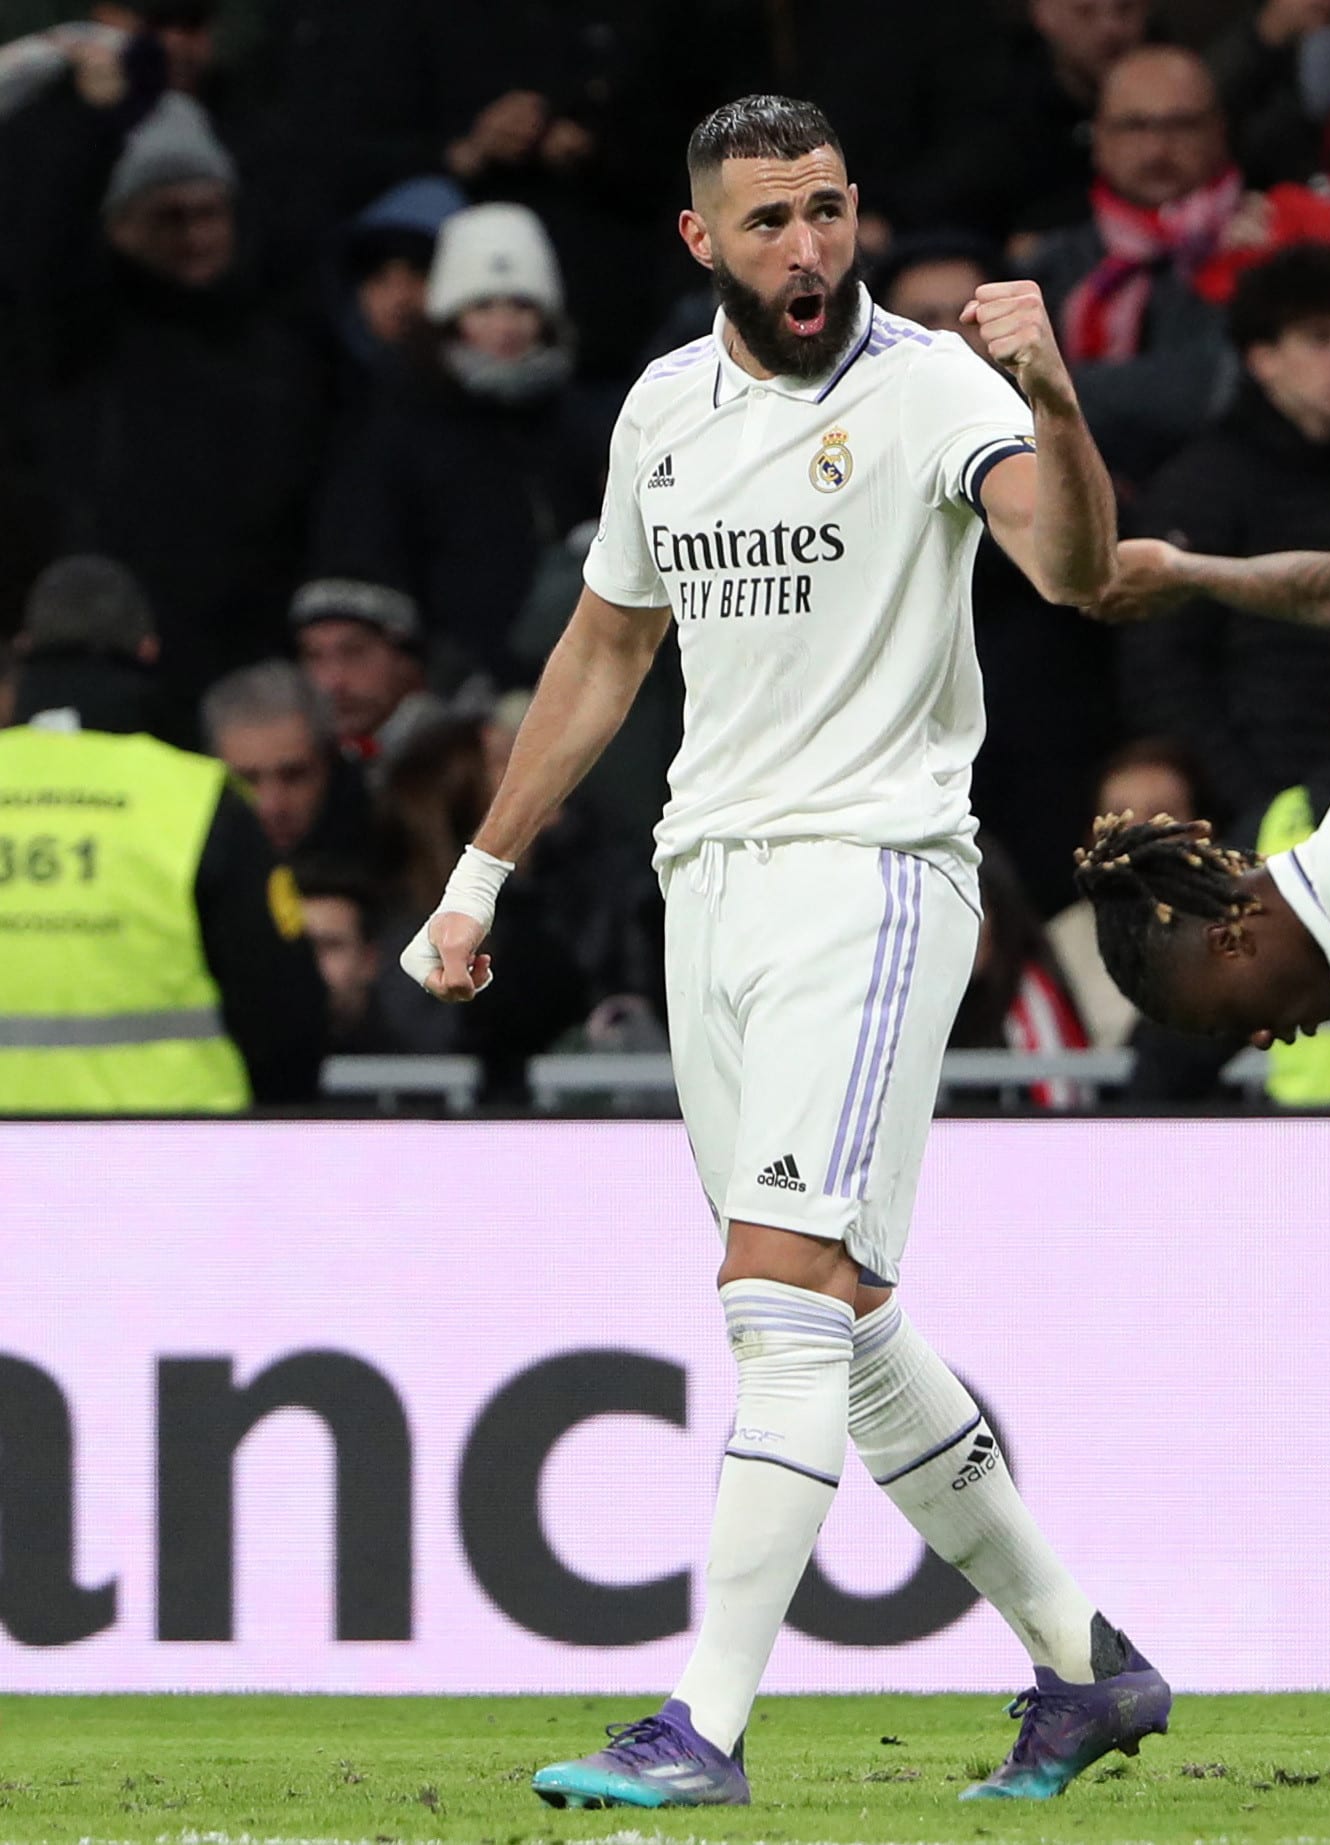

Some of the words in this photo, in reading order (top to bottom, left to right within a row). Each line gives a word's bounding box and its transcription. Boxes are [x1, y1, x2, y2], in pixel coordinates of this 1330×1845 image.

[652, 519, 845, 573] Emirates
[680, 580, 712, 620] FLY
[720, 575, 812, 618] BETTER
[757, 1170, 807, 1193] adidas
